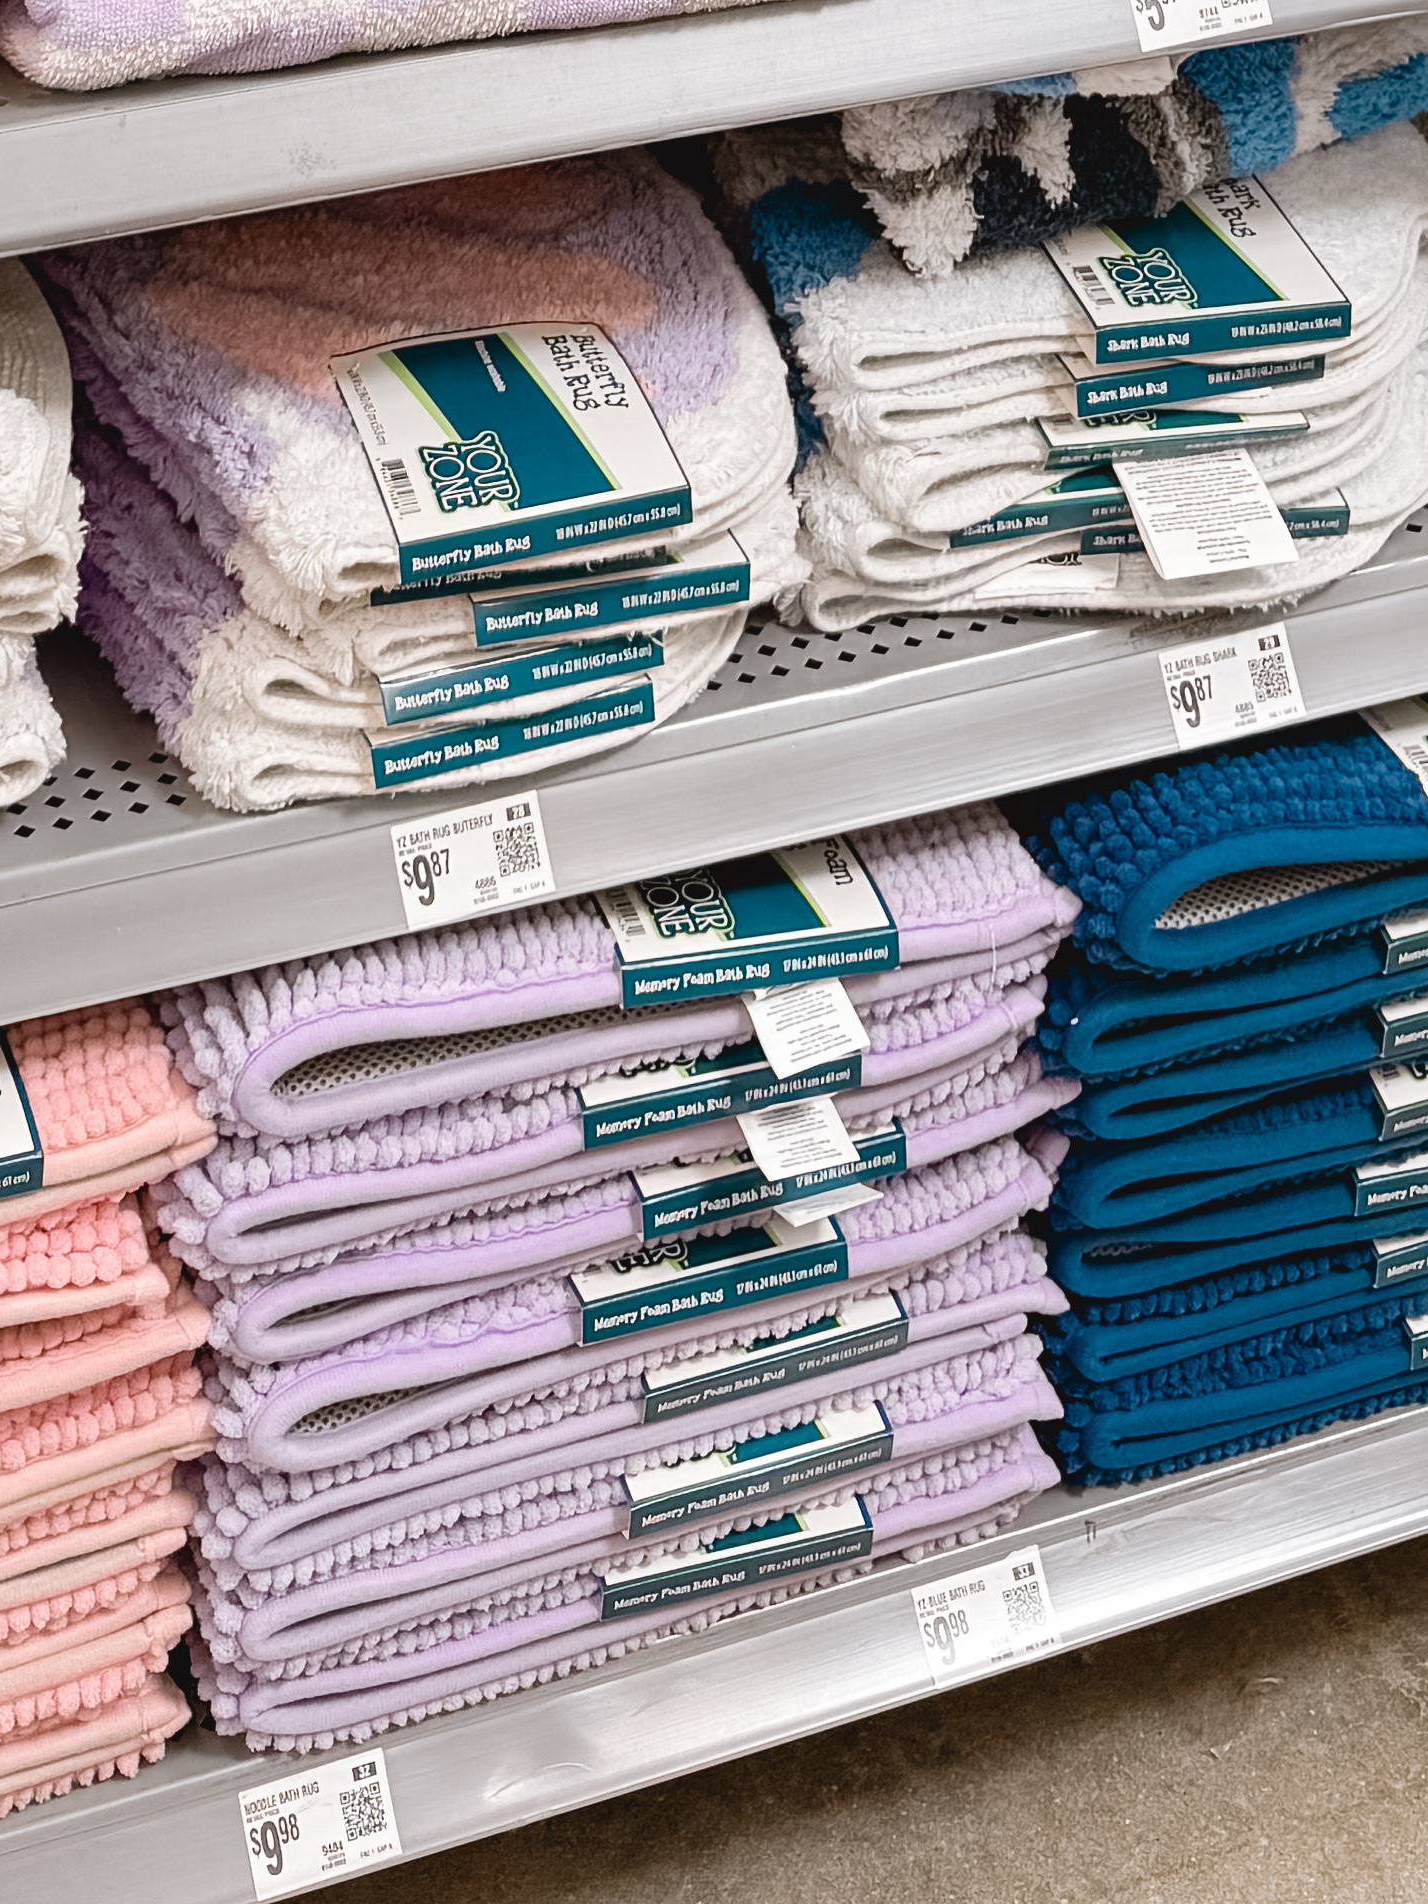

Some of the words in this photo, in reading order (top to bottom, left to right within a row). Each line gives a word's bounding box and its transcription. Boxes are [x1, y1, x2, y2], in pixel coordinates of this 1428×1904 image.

[542, 335, 576, 374] Bath
[567, 374, 600, 412] Rug
[571, 334, 629, 410] Butterfly
[424, 447, 476, 511] ZONE
[466, 433, 515, 502] YOUR
